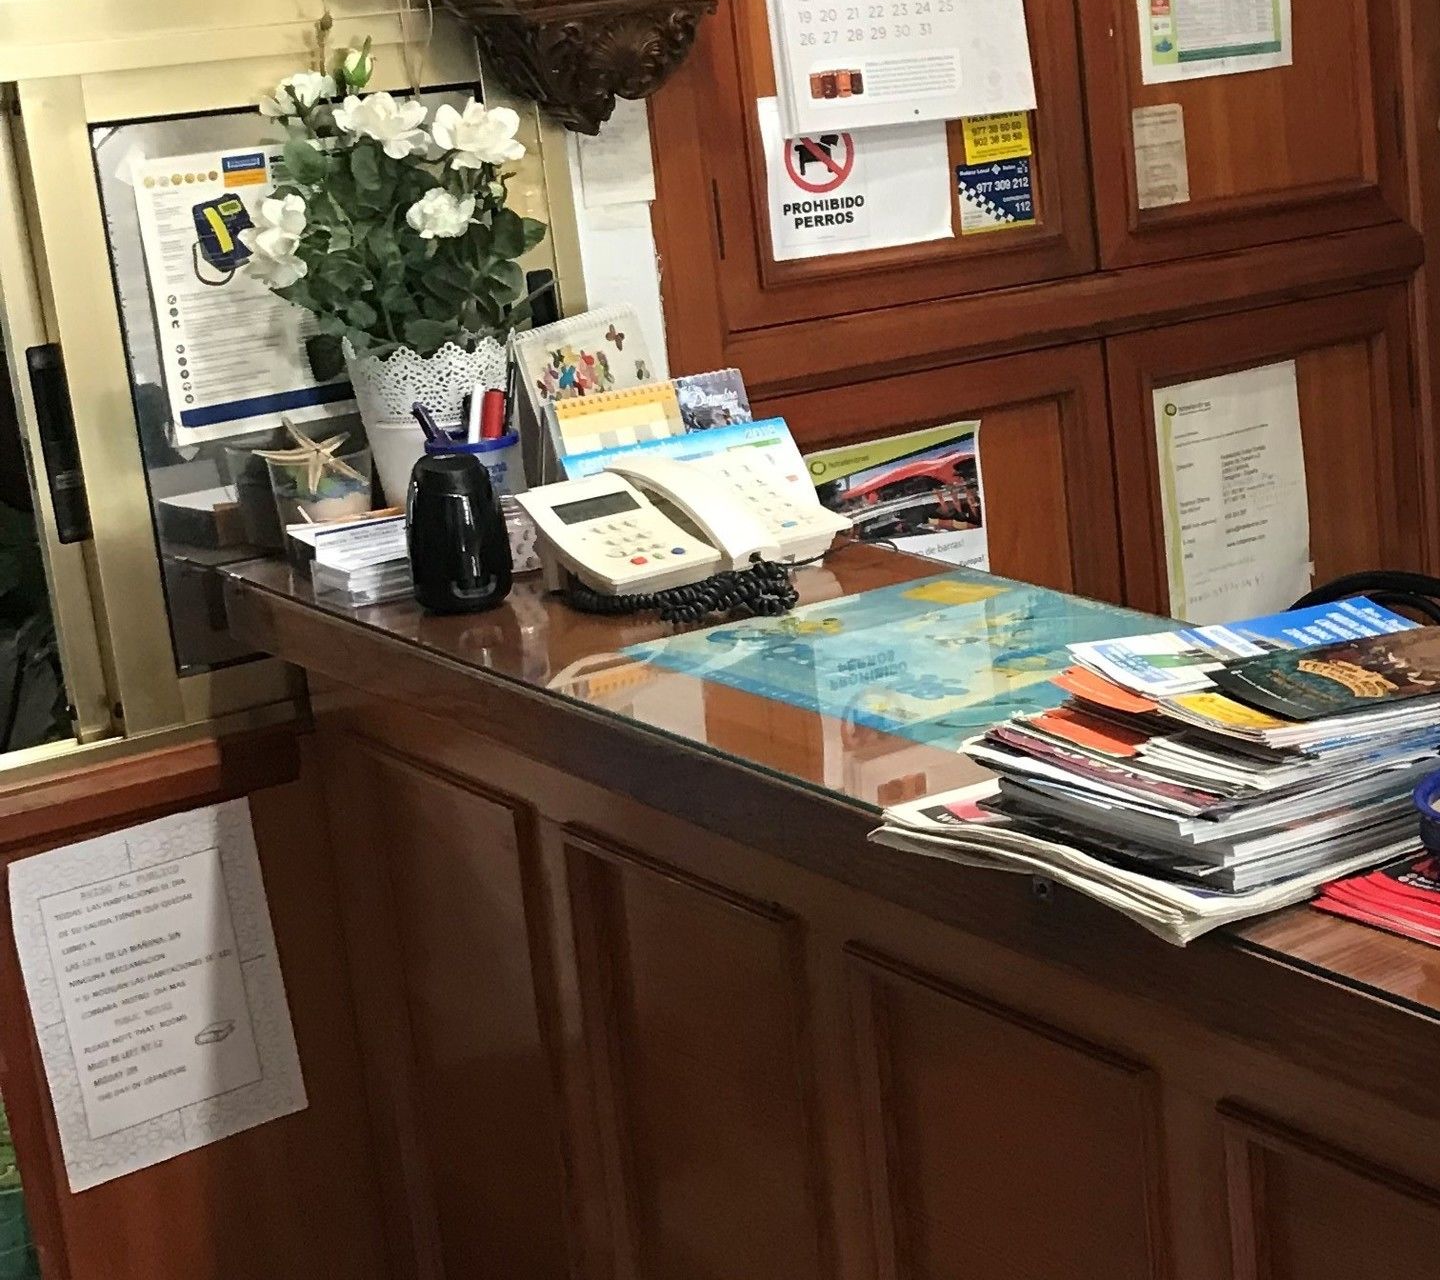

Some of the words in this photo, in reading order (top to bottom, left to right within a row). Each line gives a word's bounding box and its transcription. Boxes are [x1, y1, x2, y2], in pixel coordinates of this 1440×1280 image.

[798, 11, 811, 23] 19
[820, 9, 836, 22] 20
[846, 8, 859, 20] 21
[869, 6, 884, 18] 22
[892, 4, 908, 16] 23
[915, 2, 930, 15] 24
[938, 0, 953, 12] 25
[800, 33, 816, 46] 26
[823, 31, 838, 44] 27
[848, 29, 864, 42] 28
[871, 27, 886, 40] 29
[895, 25, 910, 38] 30
[920, 23, 932, 36] 31
[976, 182, 992, 194] 977
[1013, 177, 1029, 189] 212
[783, 194, 864, 216] PROHIBIDO
[1015, 201, 1030, 212] 112
[794, 212, 854, 229] PERROS
